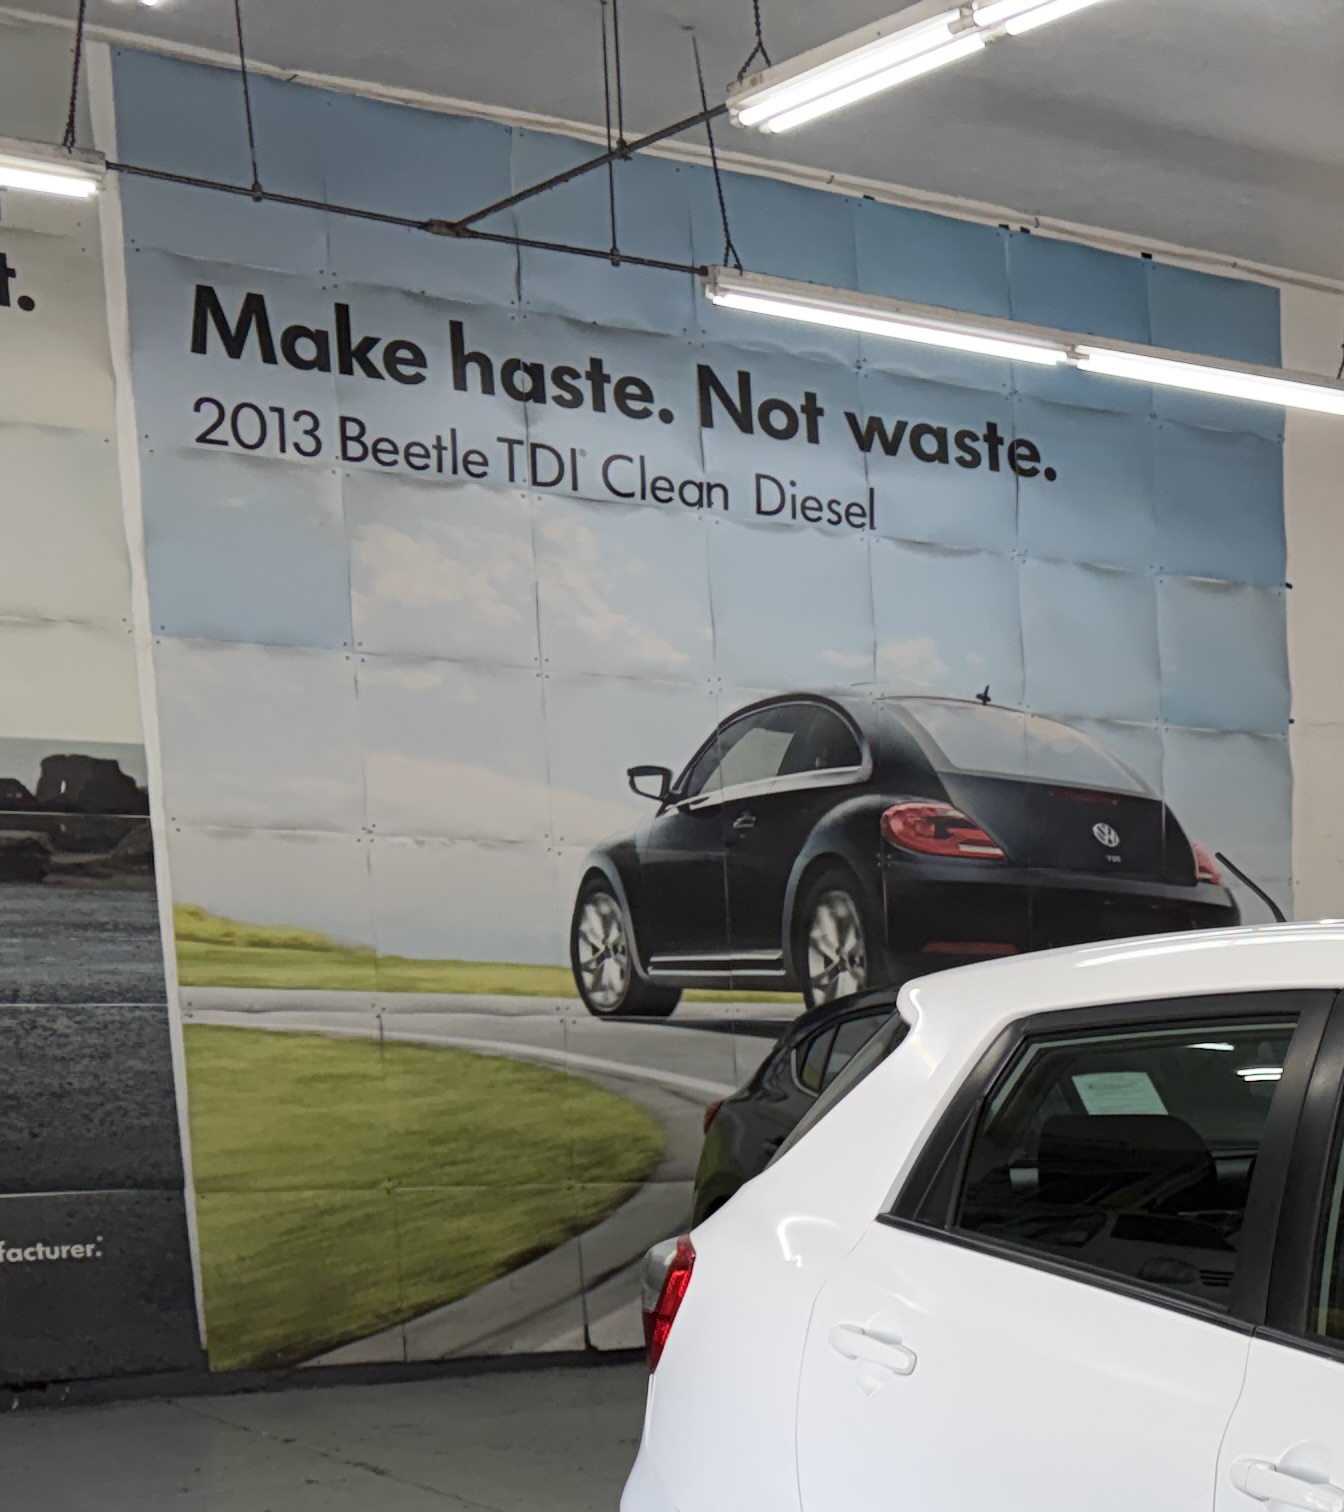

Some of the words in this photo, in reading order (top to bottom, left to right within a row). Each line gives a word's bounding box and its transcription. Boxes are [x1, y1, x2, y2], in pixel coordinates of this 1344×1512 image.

[190, 283, 428, 386] Make
[449, 319, 674, 425] haste.
[696, 363, 825, 446] Not
[843, 411, 1057, 483] waste.
[193, 396, 323, 459] 2013
[339, 415, 490, 481] Beetle
[602, 454, 729, 511] Clean
[755, 473, 876, 531] Diesel
